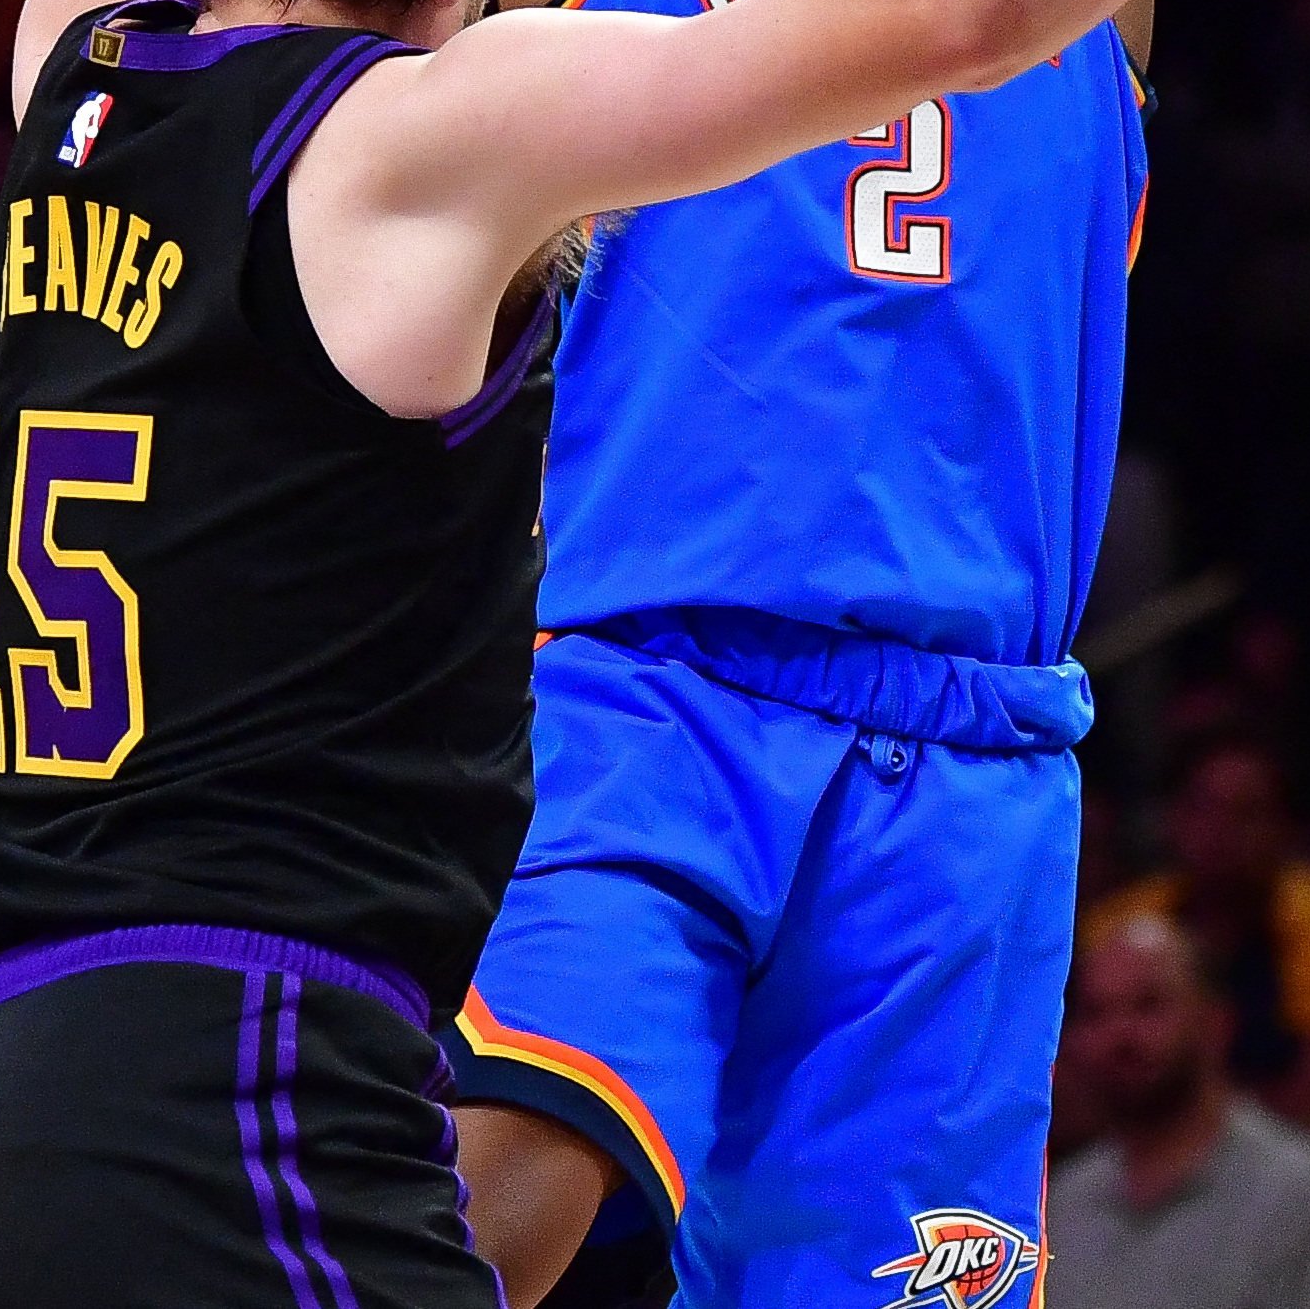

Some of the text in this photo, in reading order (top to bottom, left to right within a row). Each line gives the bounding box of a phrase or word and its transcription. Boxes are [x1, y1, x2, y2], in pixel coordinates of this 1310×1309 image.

[844, 95, 951, 285] 2
[0, 192, 186, 350] EAVES
[911, 1236, 1000, 1292] OKC
